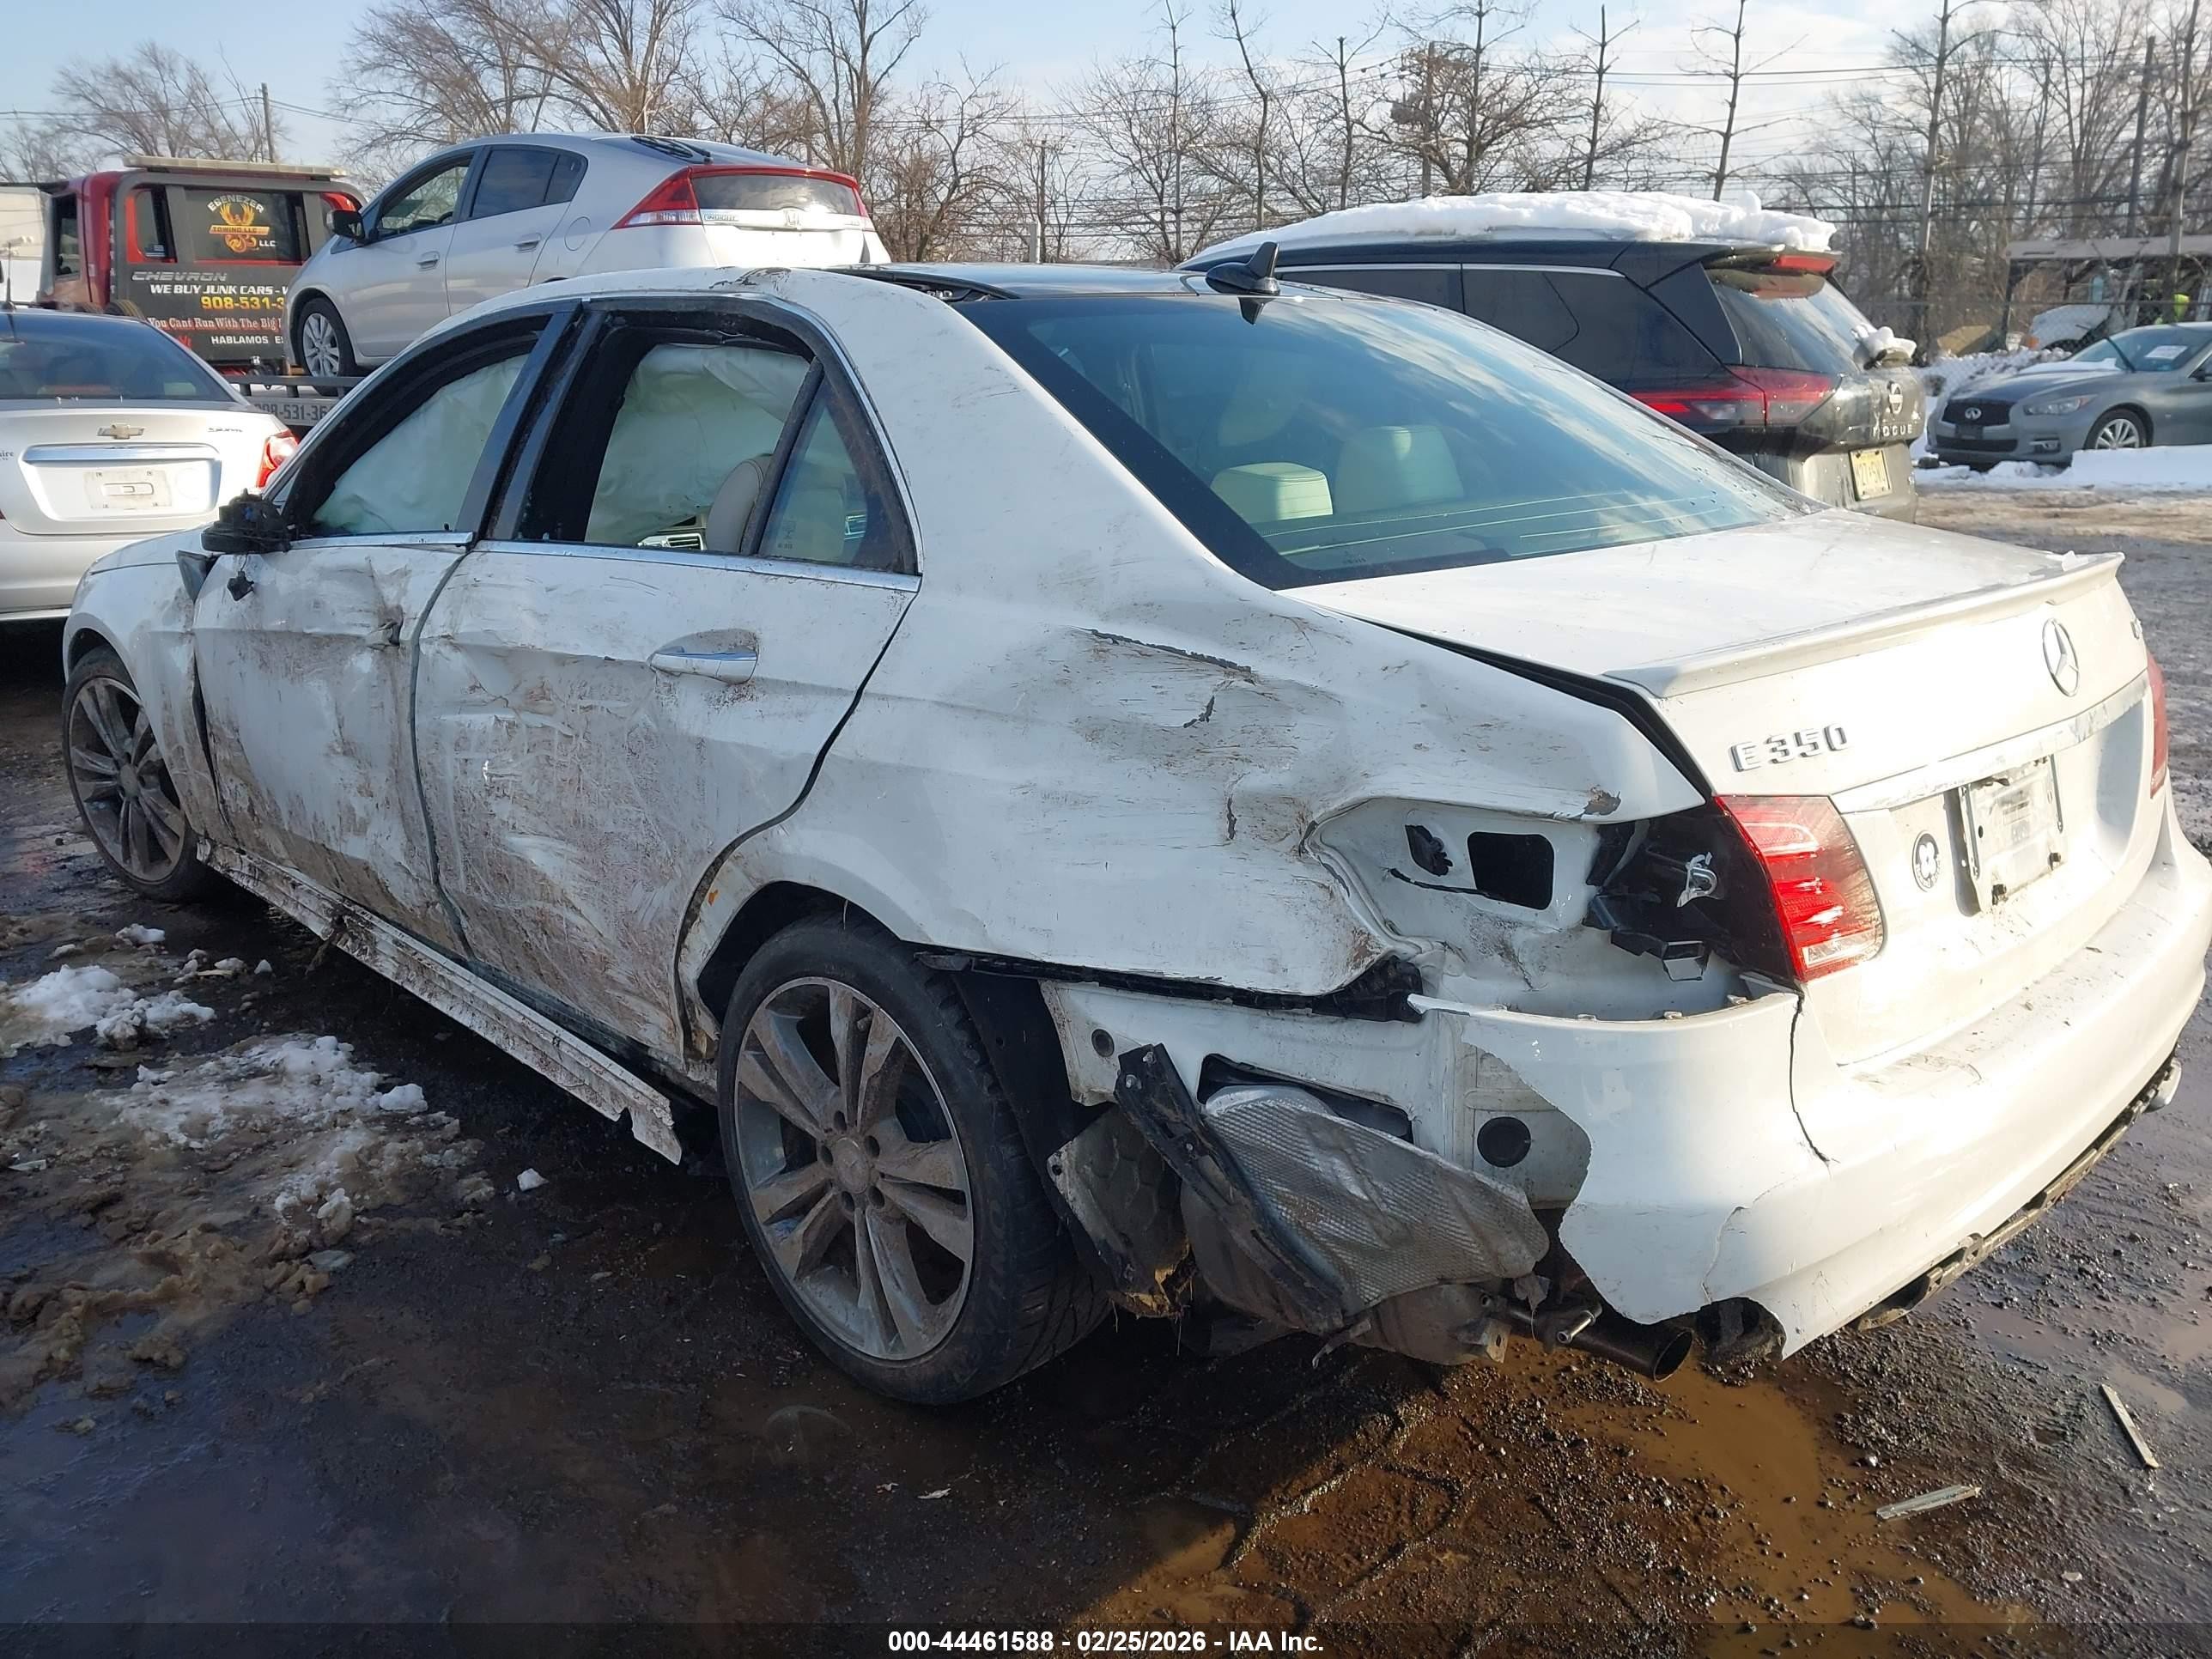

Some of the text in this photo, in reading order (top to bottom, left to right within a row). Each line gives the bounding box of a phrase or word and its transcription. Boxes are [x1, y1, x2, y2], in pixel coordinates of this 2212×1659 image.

[207, 194, 264, 213] EBENEZER
[131, 271, 227, 281] CHEVRON
[149, 284, 172, 294] WE
[173, 284, 201, 294] BUY
[203, 285, 238, 295] JUNK
[240, 286, 274, 295] CARS
[147, 317, 167, 328] You
[193, 317, 215, 328] Run
[215, 317, 237, 328] With
[240, 317, 258, 328] The
[260, 317, 276, 330] Big
